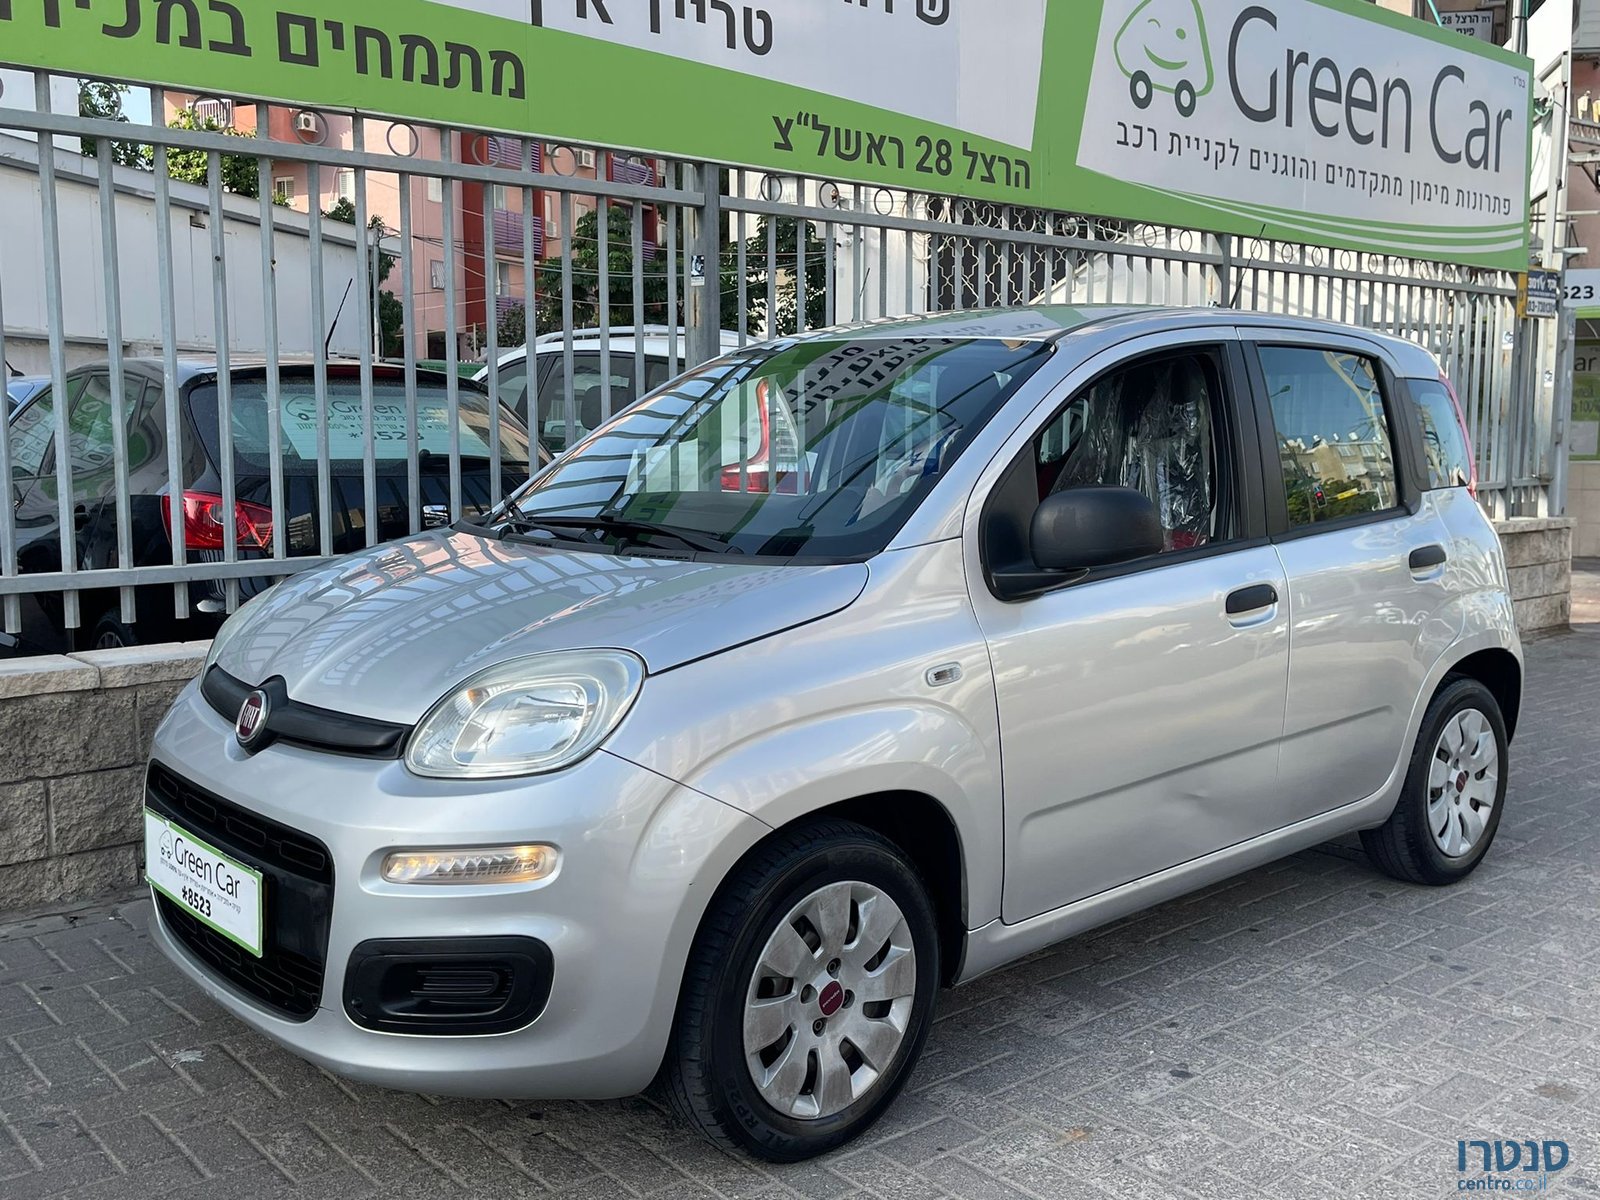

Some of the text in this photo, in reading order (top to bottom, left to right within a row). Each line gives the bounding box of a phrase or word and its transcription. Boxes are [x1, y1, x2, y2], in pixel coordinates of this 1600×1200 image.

[1441, 15, 1452, 24] 28
[1455, 13, 1479, 24] הרצל
[276, 11, 525, 99] מתמחים
[1228, 5, 1512, 174] Green Car
[915, 135, 952, 176] 28
[962, 141, 1031, 189] הרצל
[1116, 121, 1511, 216] פתרונות מימון מתקדמים והוגנים לקניית רכב
[331, 400, 402, 414] Gren
[174, 837, 213, 884] Green
[215, 862, 240, 899] Car
